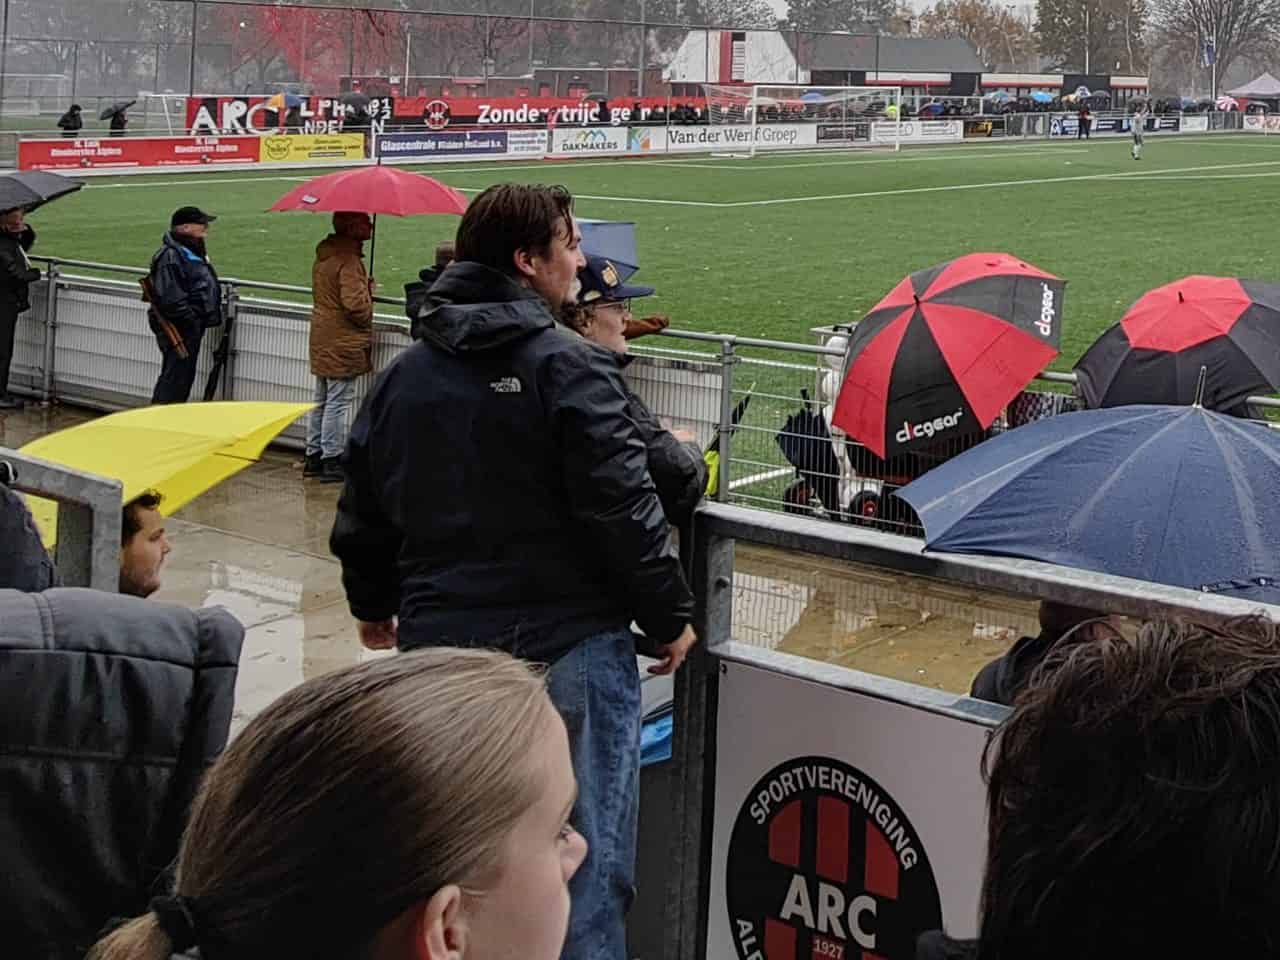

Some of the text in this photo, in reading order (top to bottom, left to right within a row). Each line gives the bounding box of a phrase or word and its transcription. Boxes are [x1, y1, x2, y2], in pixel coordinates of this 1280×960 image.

[190, 100, 279, 135] ARC
[561, 141, 618, 152] DAKMAKERS
[669, 129, 695, 144] Van
[698, 128, 721, 143] der
[762, 127, 798, 145] Groep
[750, 765, 918, 871] SPORTVERENIGING
[779, 873, 878, 950] ARC
[813, 939, 845, 960] 1927
